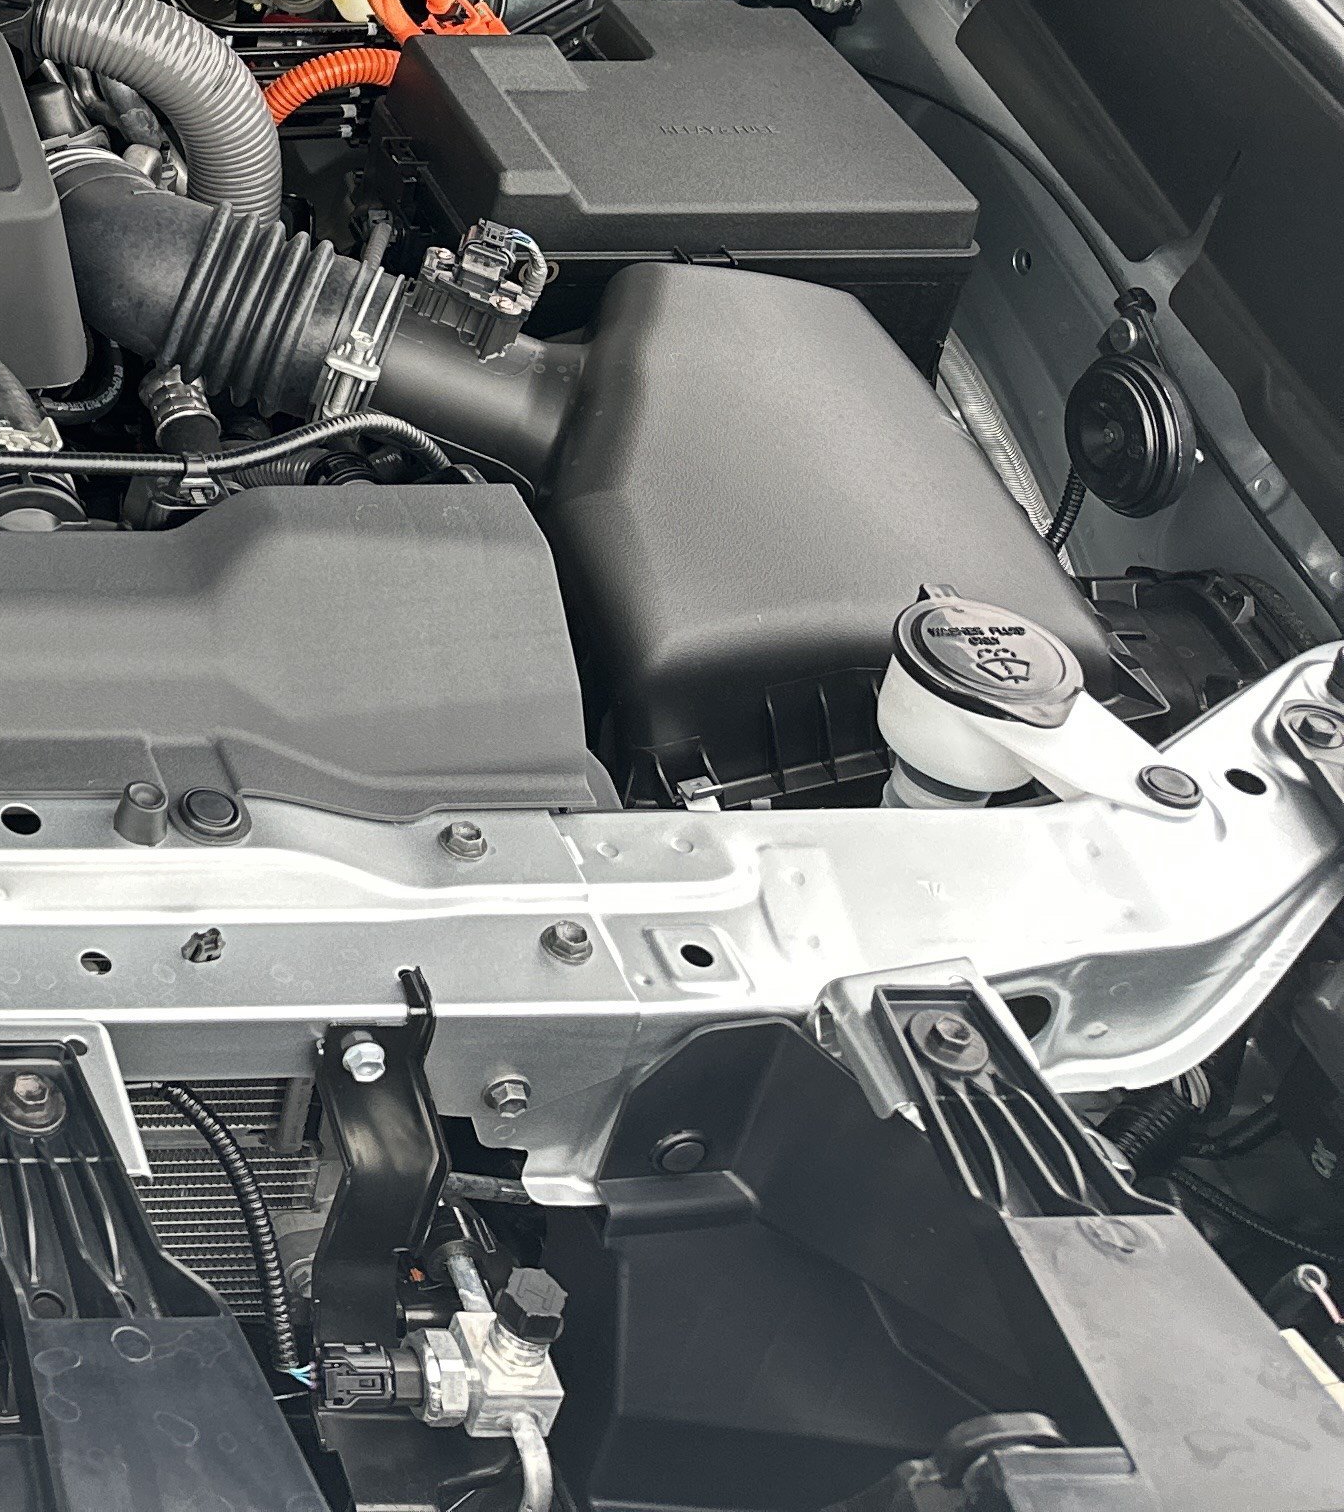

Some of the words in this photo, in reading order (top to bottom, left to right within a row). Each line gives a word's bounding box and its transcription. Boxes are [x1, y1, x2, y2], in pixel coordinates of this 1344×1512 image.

[927, 626, 985, 637] WASHER
[988, 626, 1026, 637] FLUID
[968, 636, 1000, 646] ONLY
